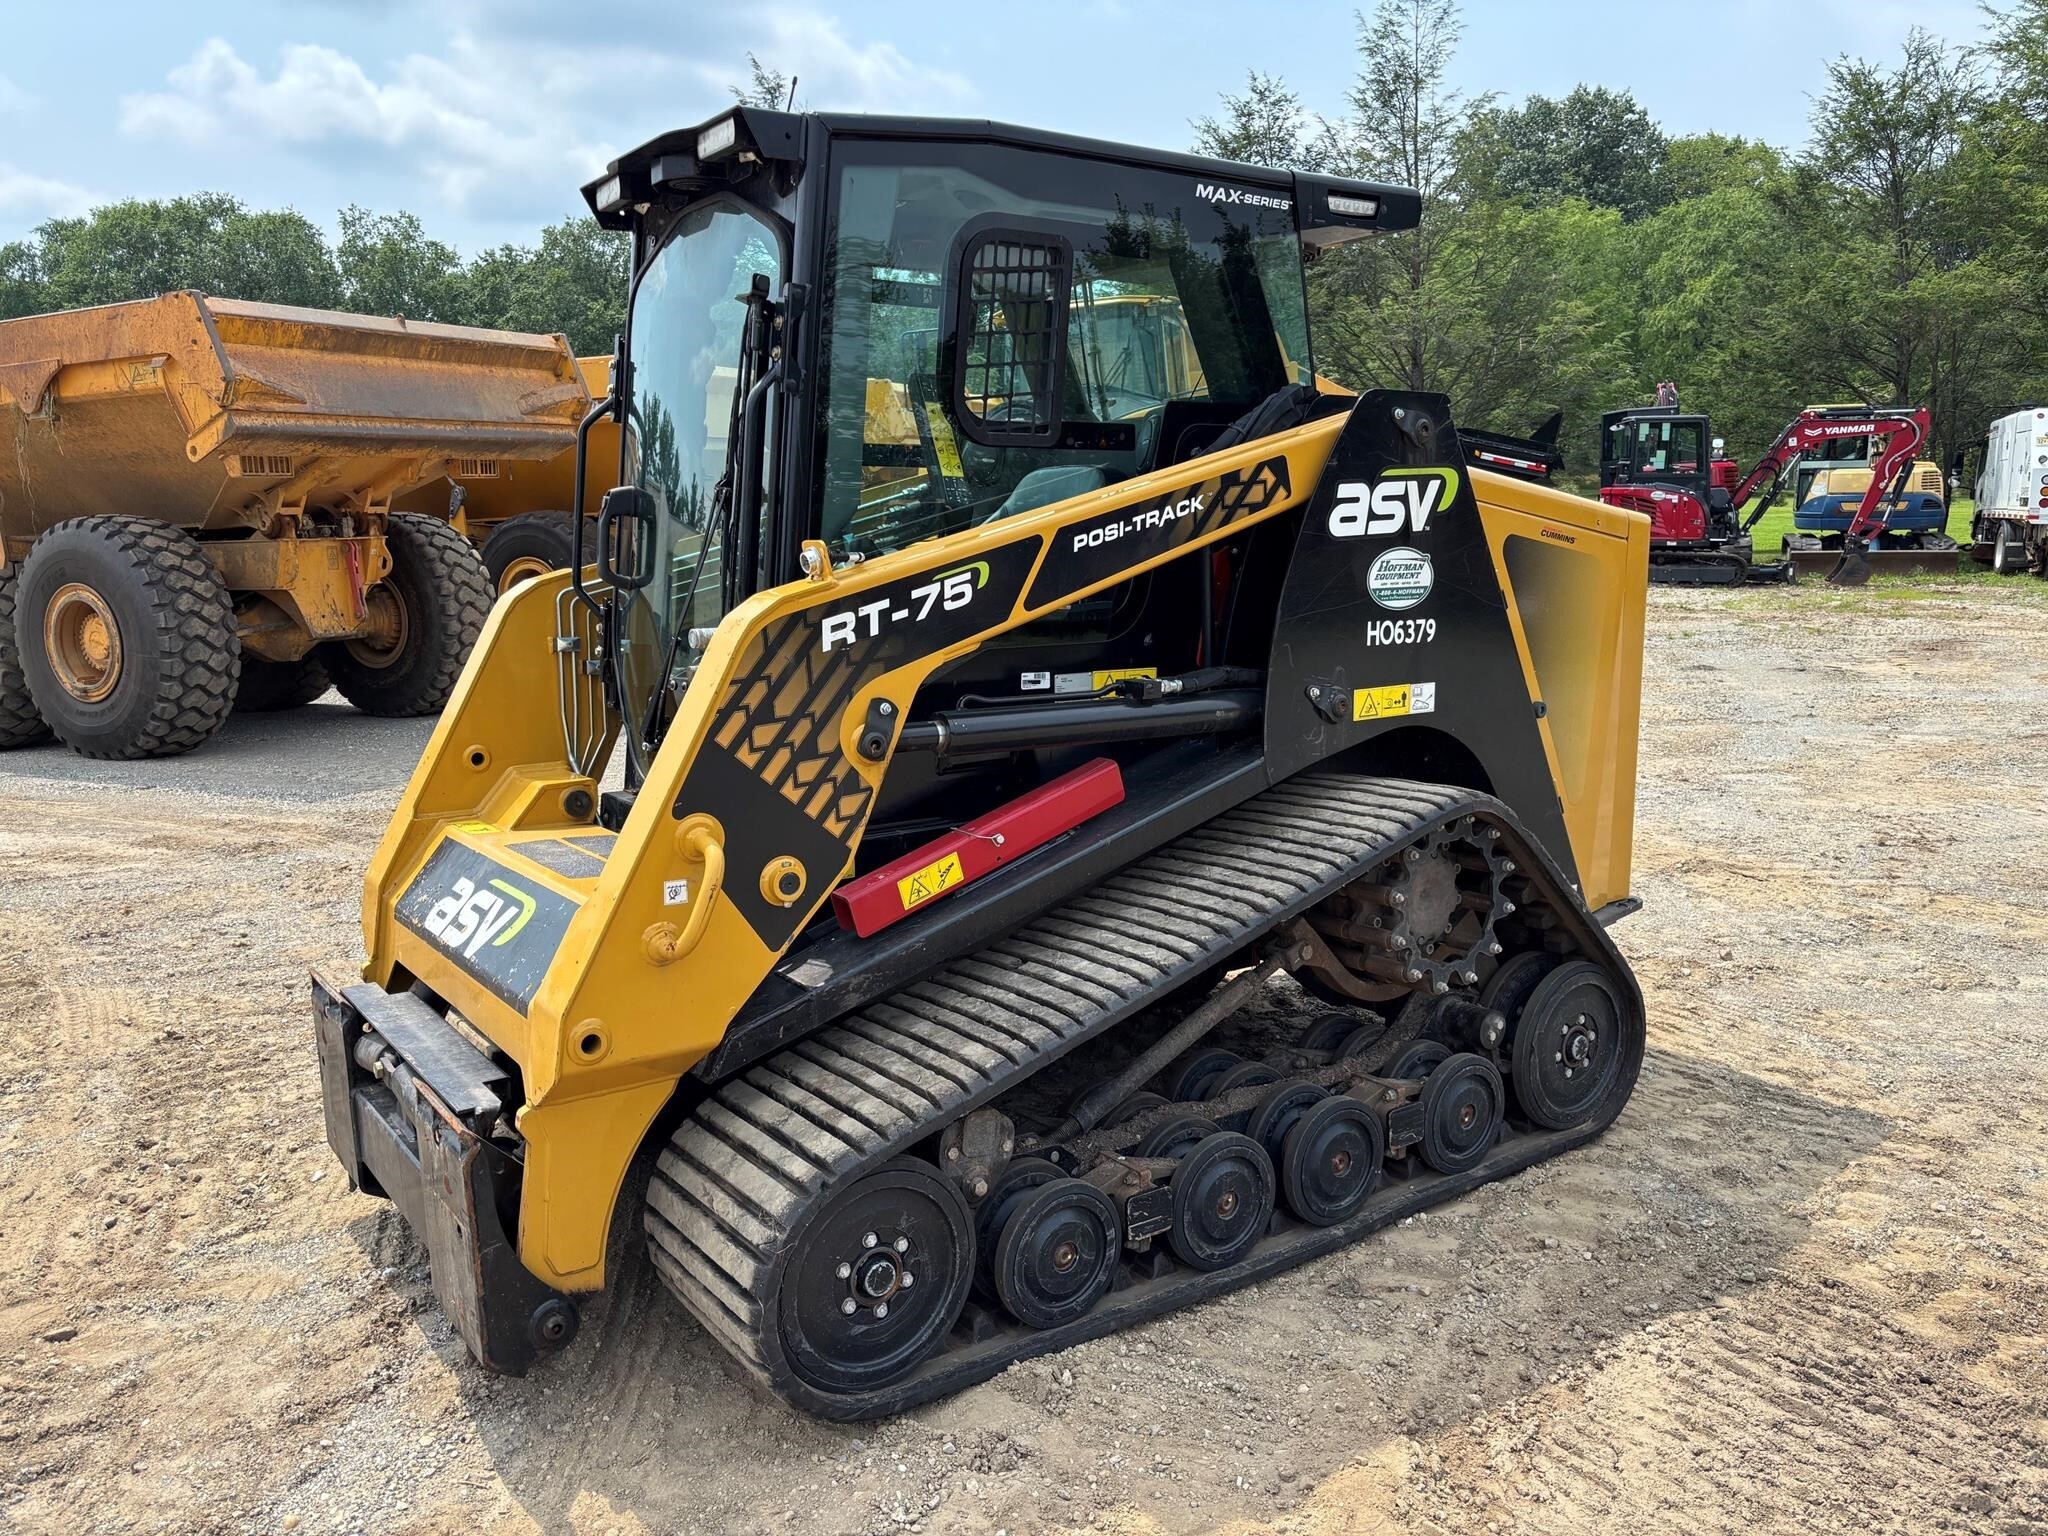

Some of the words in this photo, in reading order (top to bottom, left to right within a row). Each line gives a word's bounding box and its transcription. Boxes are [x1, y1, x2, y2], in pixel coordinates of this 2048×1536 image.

[1195, 183, 1293, 210] MAX-SERIES
[1824, 424, 1875, 435] YANMAR
[1073, 495, 1205, 553] POSI-TRACK
[1540, 529, 1576, 544] CUMMINS
[1376, 560, 1425, 573] HOFFMAN
[1374, 571, 1422, 581] EQUIPMENT
[821, 571, 973, 653] RT-75
